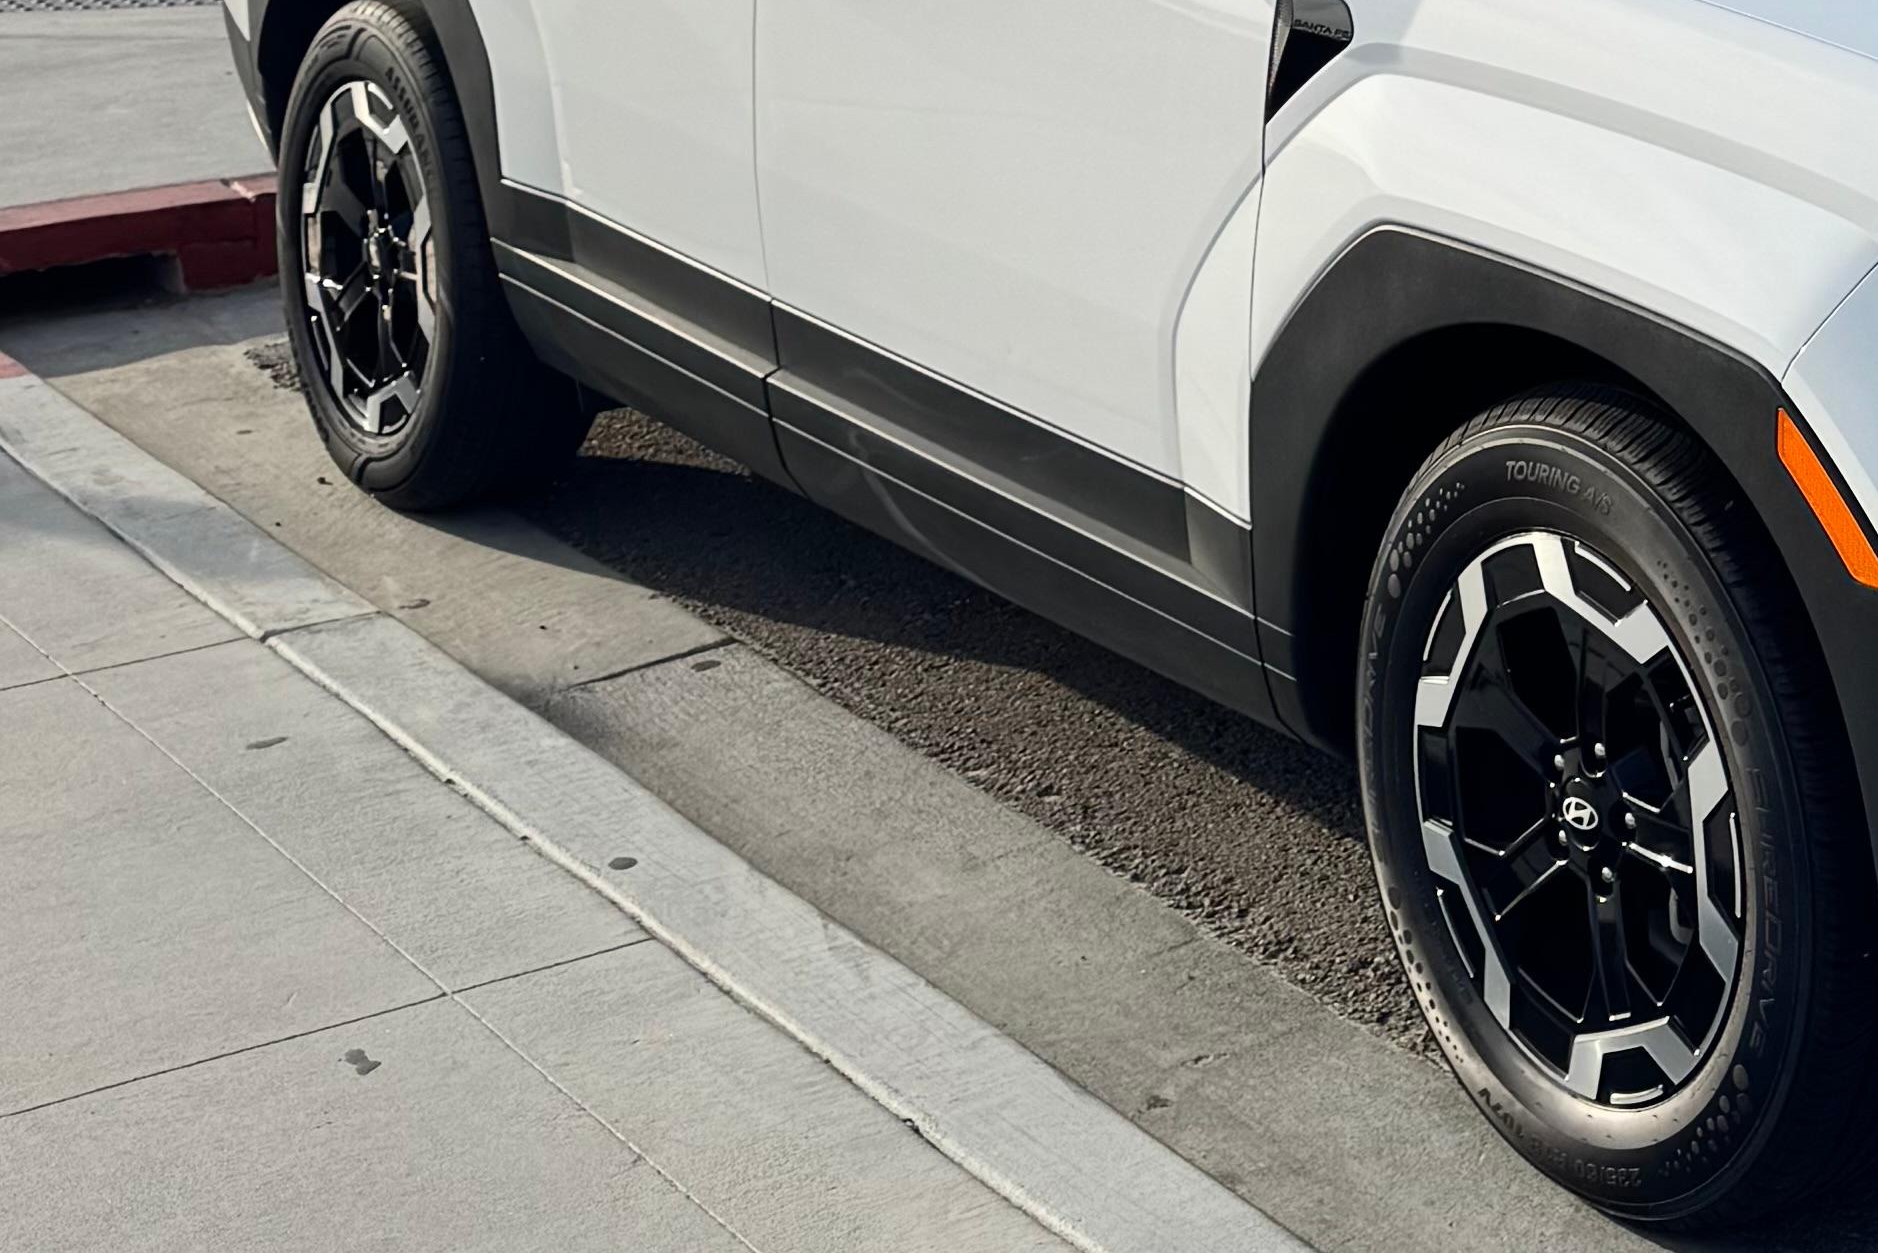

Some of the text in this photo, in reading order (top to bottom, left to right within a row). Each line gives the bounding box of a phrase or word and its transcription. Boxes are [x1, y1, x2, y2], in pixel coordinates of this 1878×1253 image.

[1294, 19, 1332, 35] SANTA
[1506, 460, 1612, 516] TOURING A/S
